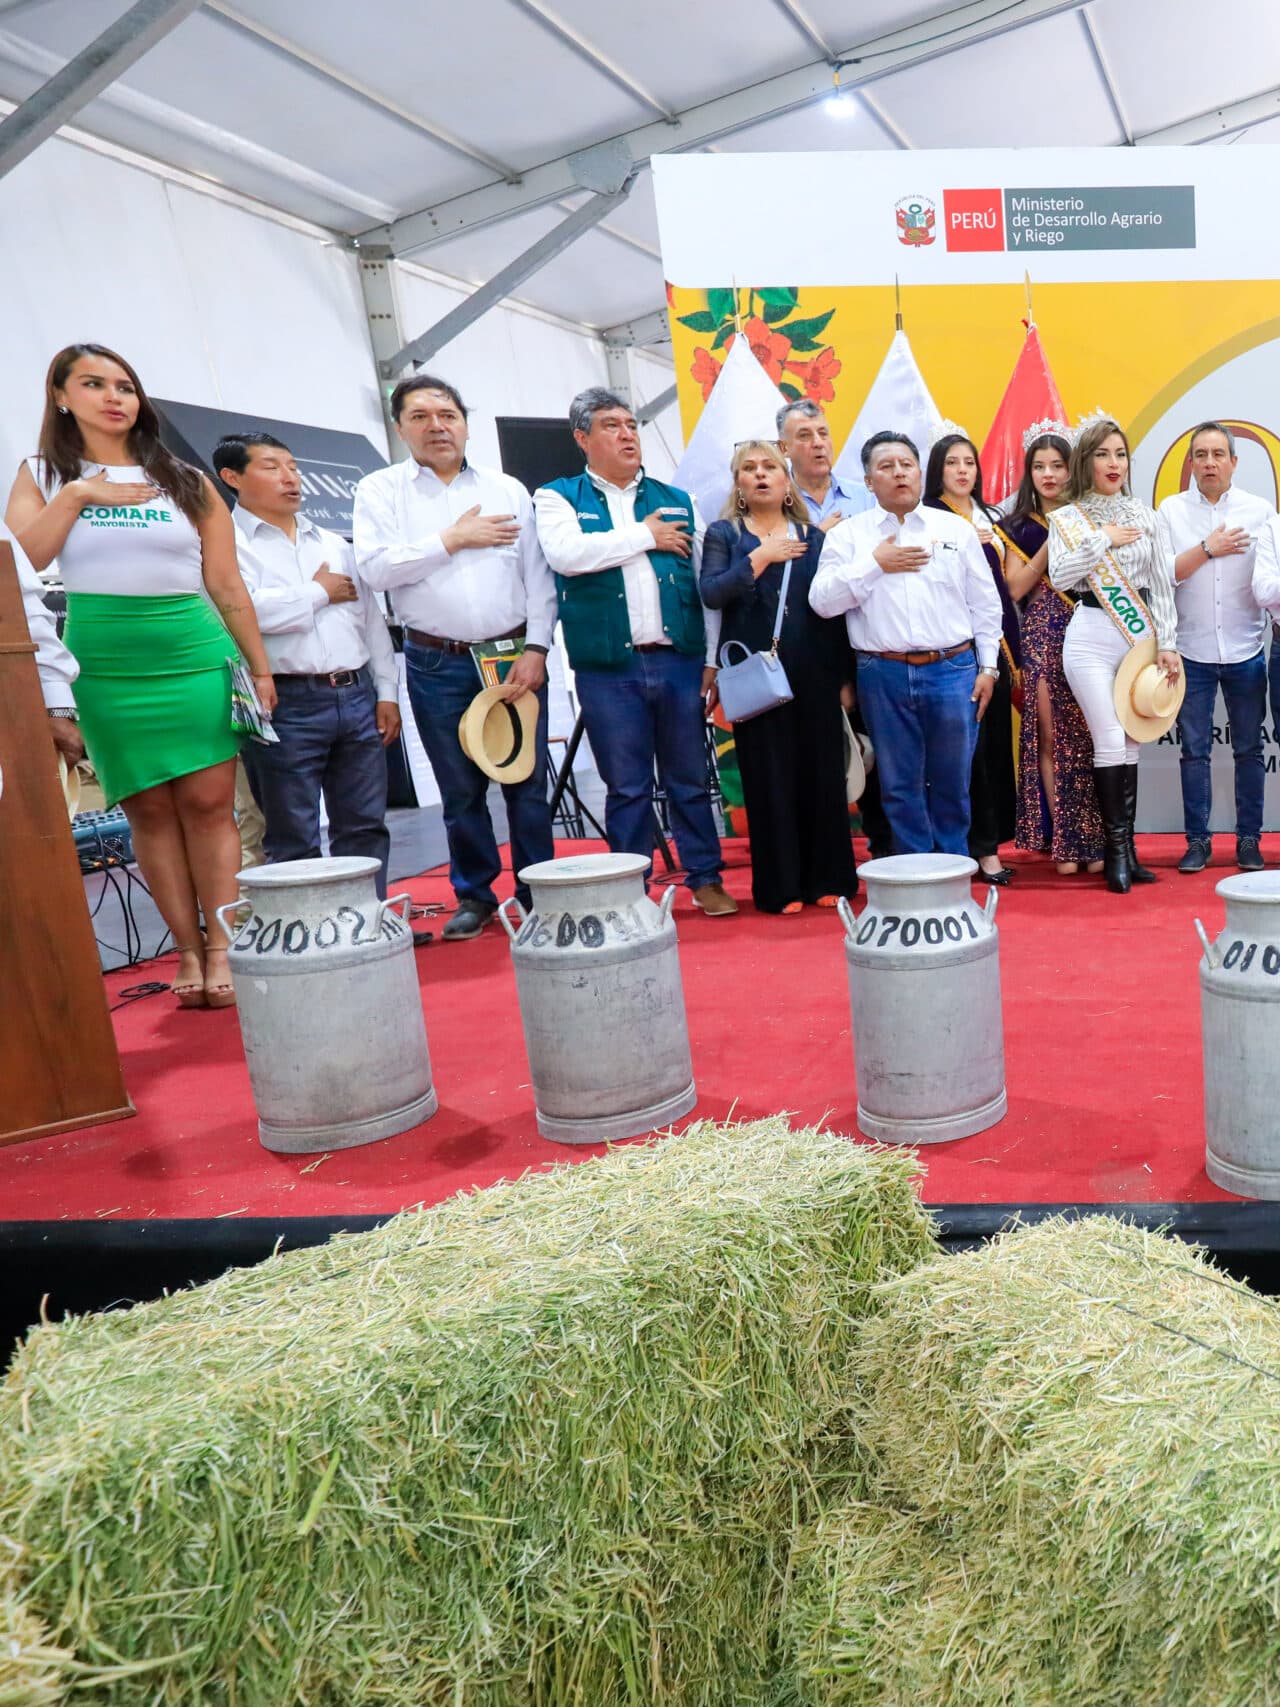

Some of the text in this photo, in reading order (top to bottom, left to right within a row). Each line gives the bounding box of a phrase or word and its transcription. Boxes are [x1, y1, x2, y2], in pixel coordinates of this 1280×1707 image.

[1012, 197, 1084, 212] Ministerio
[951, 208, 998, 229] PERÚ
[1012, 211, 1163, 228] de Desarrollo Agrario
[1013, 228, 1065, 246] y Riego
[78, 507, 172, 522] COMARE
[91, 520, 149, 529] MAYORISTA
[856, 911, 978, 947] 070001
